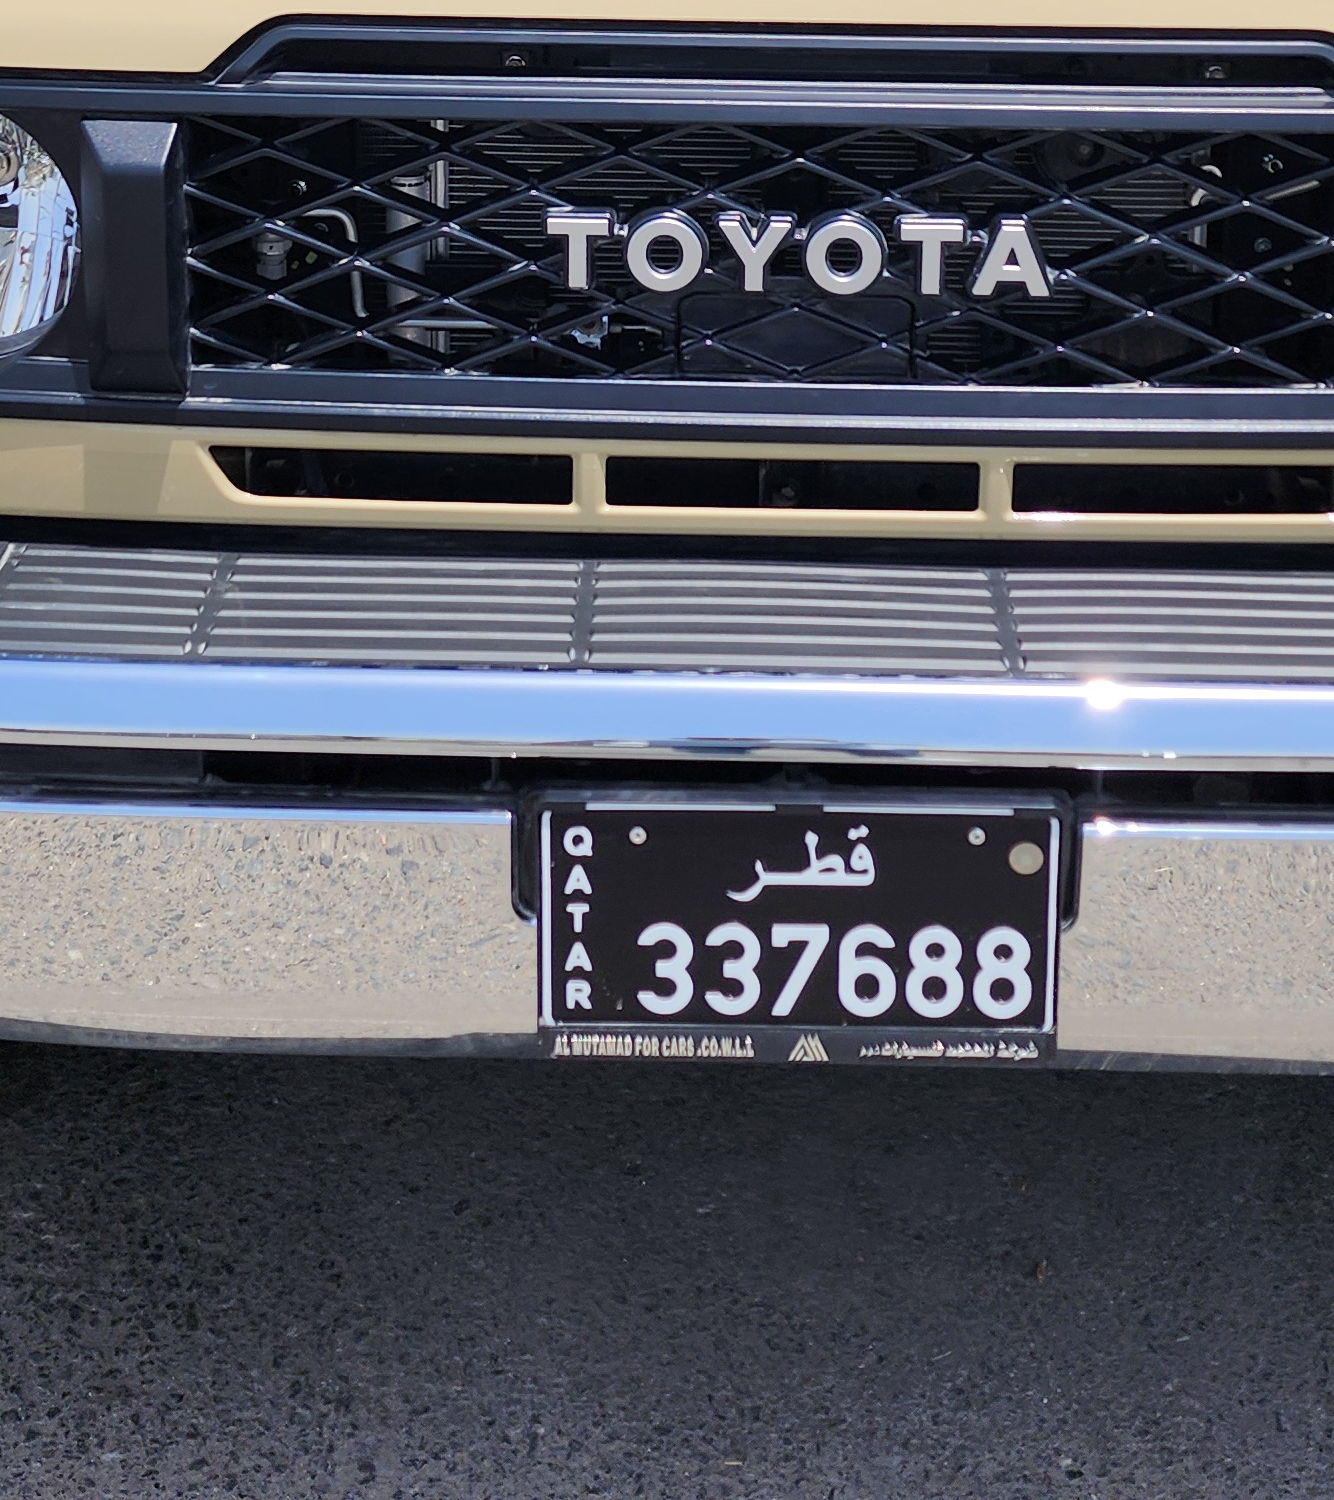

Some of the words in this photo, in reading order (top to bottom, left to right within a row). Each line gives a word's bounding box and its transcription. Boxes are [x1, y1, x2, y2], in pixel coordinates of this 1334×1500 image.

[545, 209, 1051, 297] TOYOTA
[725, 824, 876, 902] قطر
[563, 825, 593, 1011] QATAR
[636, 921, 1033, 1020] 337688
[634, 1034, 660, 1057] FOR
[661, 1034, 695, 1057] CARS
